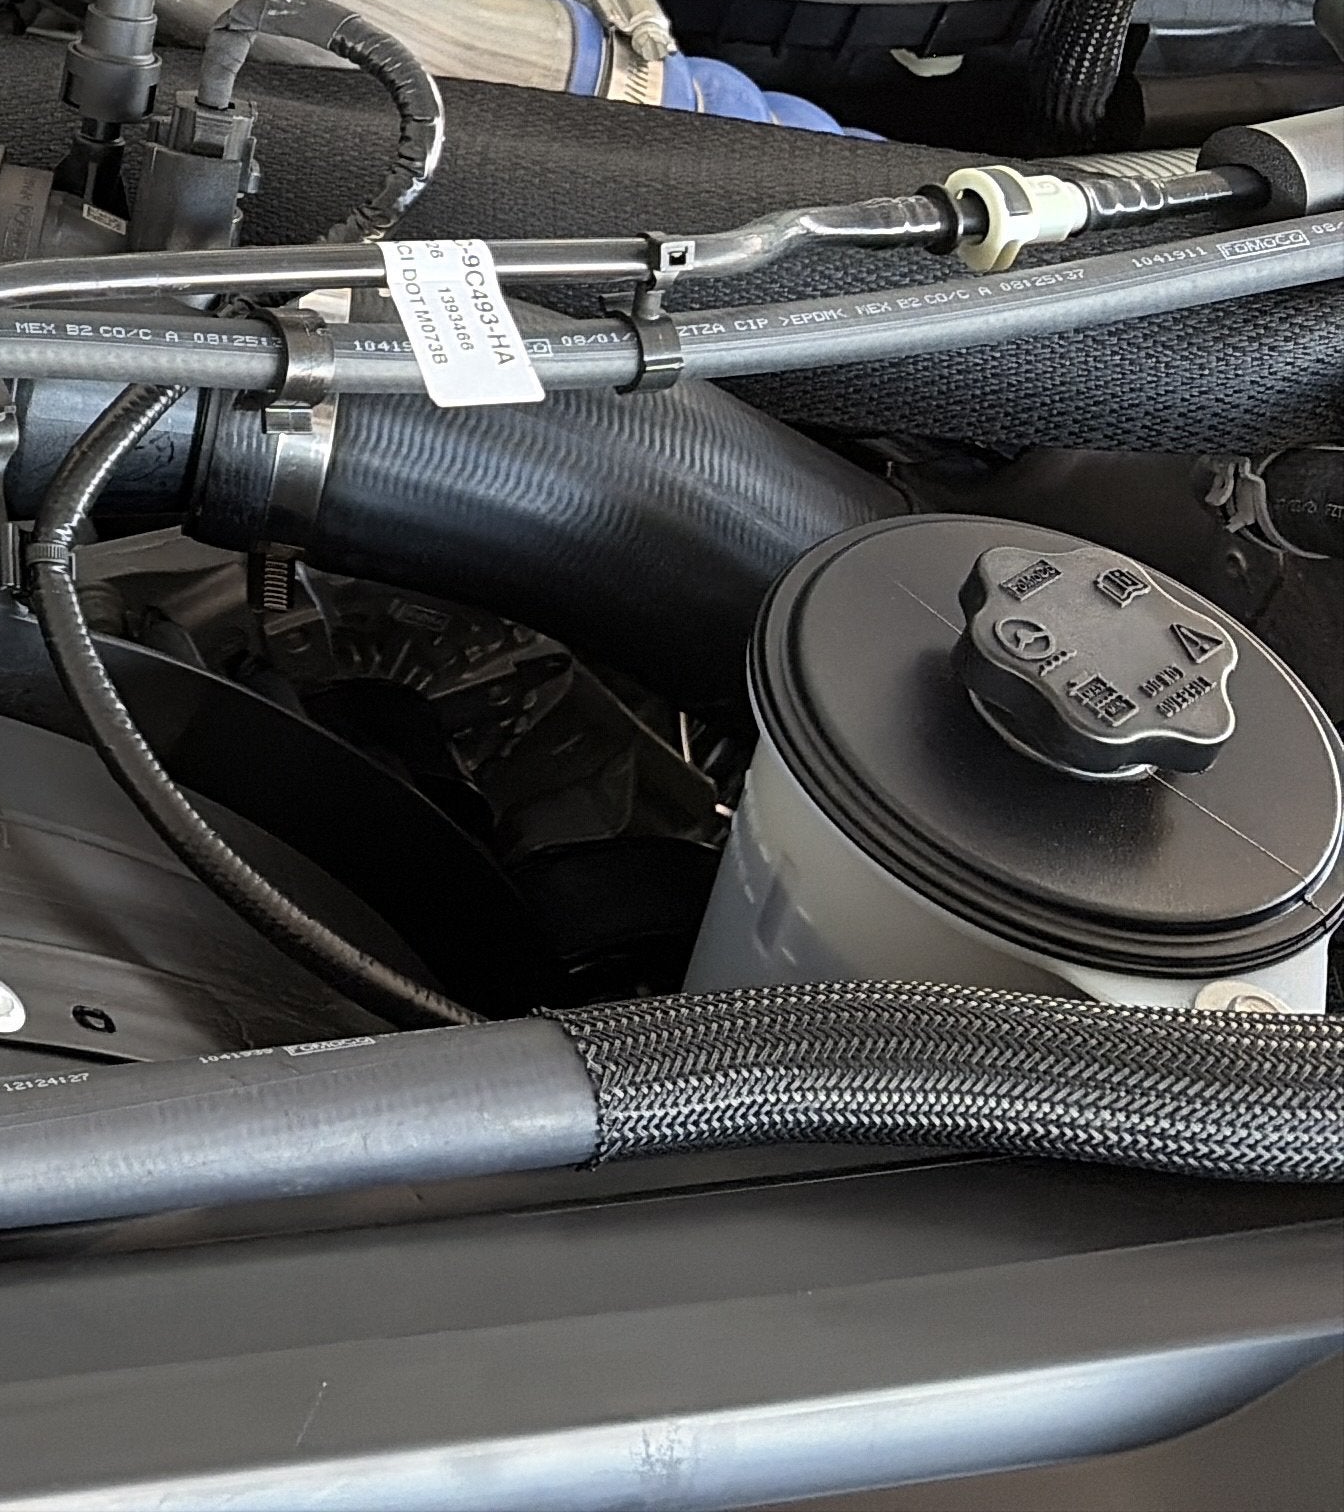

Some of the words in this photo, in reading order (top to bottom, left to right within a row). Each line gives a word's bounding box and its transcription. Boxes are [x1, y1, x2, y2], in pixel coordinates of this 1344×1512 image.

[1131, 245, 1208, 270] 1041911
[1221, 232, 1307, 259] FoMoCo
[15, 320, 57, 336] MEX
[65, 324, 94, 337] B2
[99, 326, 153, 341] CO/C
[164, 330, 180, 343] A
[402, 268, 426, 305] DOT
[414, 310, 449, 365] M073B
[438, 287, 475, 351] 1393466
[676, 322, 725, 338] ZTZA
[734, 317, 768, 333] CIP
[856, 301, 892, 317] MEX
[897, 297, 922, 311] B2
[925, 289, 970, 306] CO/C
[979, 285, 993, 298] A
